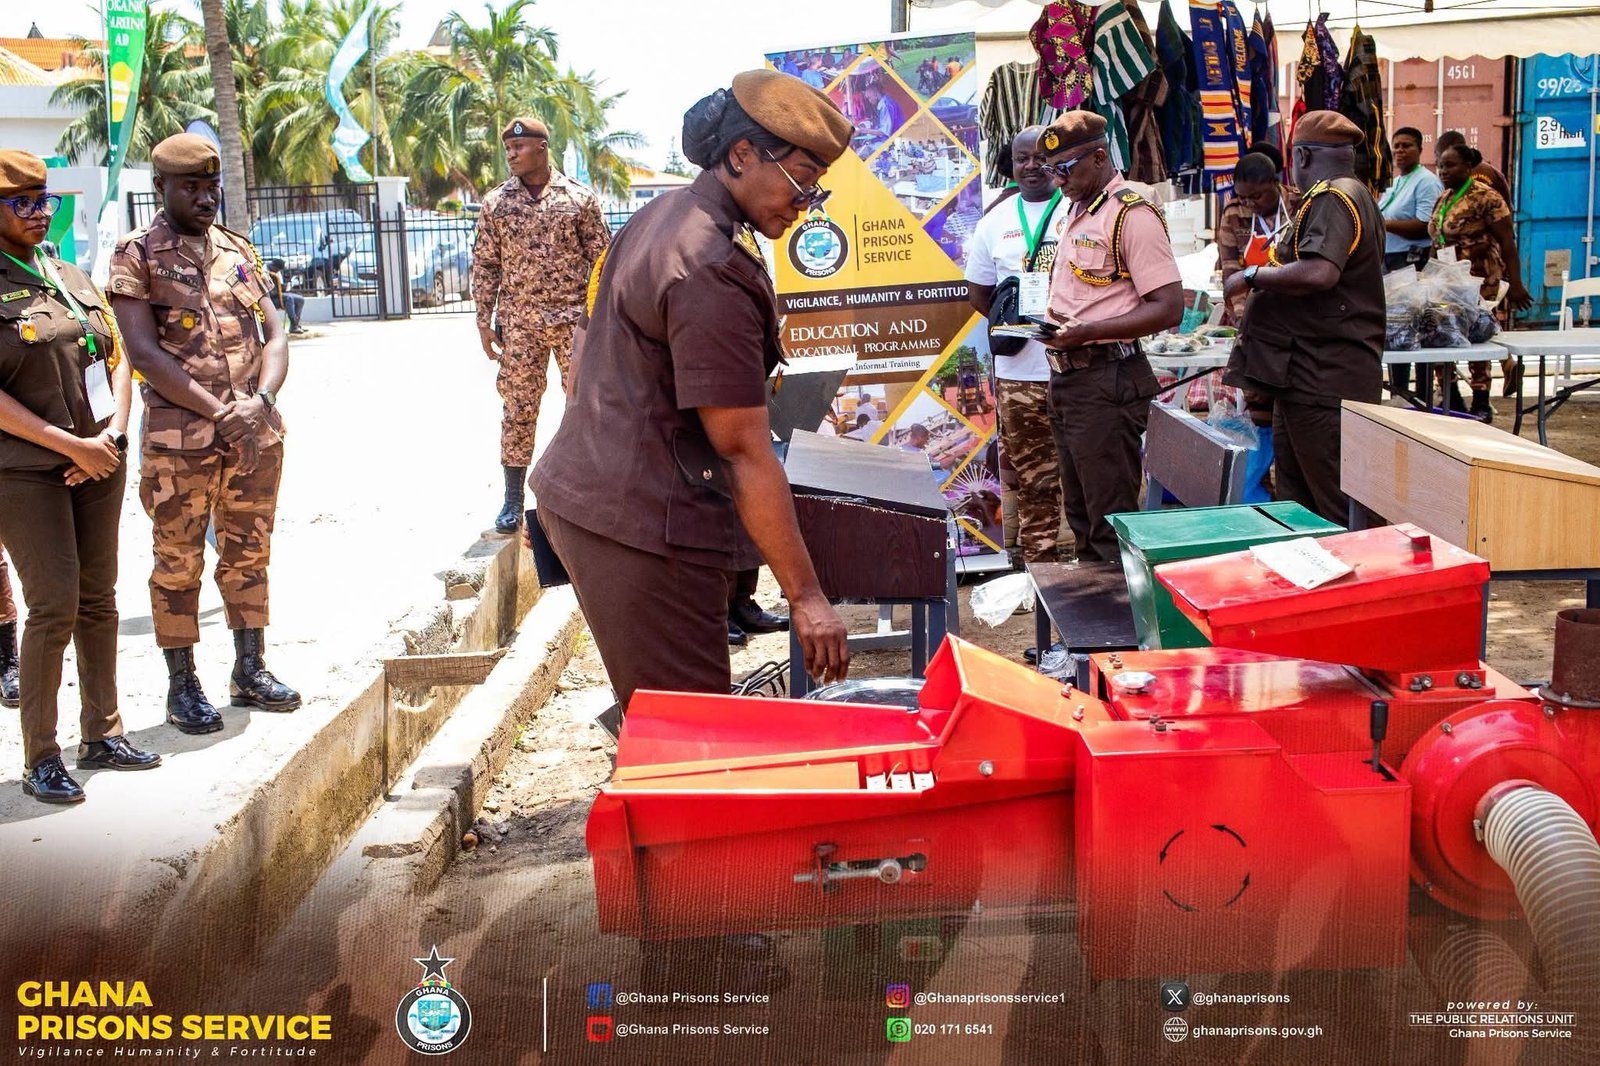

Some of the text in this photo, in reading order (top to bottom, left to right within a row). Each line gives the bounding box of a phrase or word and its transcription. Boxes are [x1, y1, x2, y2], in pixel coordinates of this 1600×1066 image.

[1233, 28, 1247, 72] WELCOME
[862, 218, 906, 232] GHANA
[863, 234, 914, 248] PRISONS
[864, 250, 912, 264] SERVICE
[786, 286, 969, 309] VIGILANCE, HUMANITY & FORTITUD
[790, 319, 928, 342] EDUCATION AND
[791, 338, 941, 358] VOCATIONAL PROGRAMMES
[855, 361, 888, 371] Informal
[890, 359, 921, 369] Training
